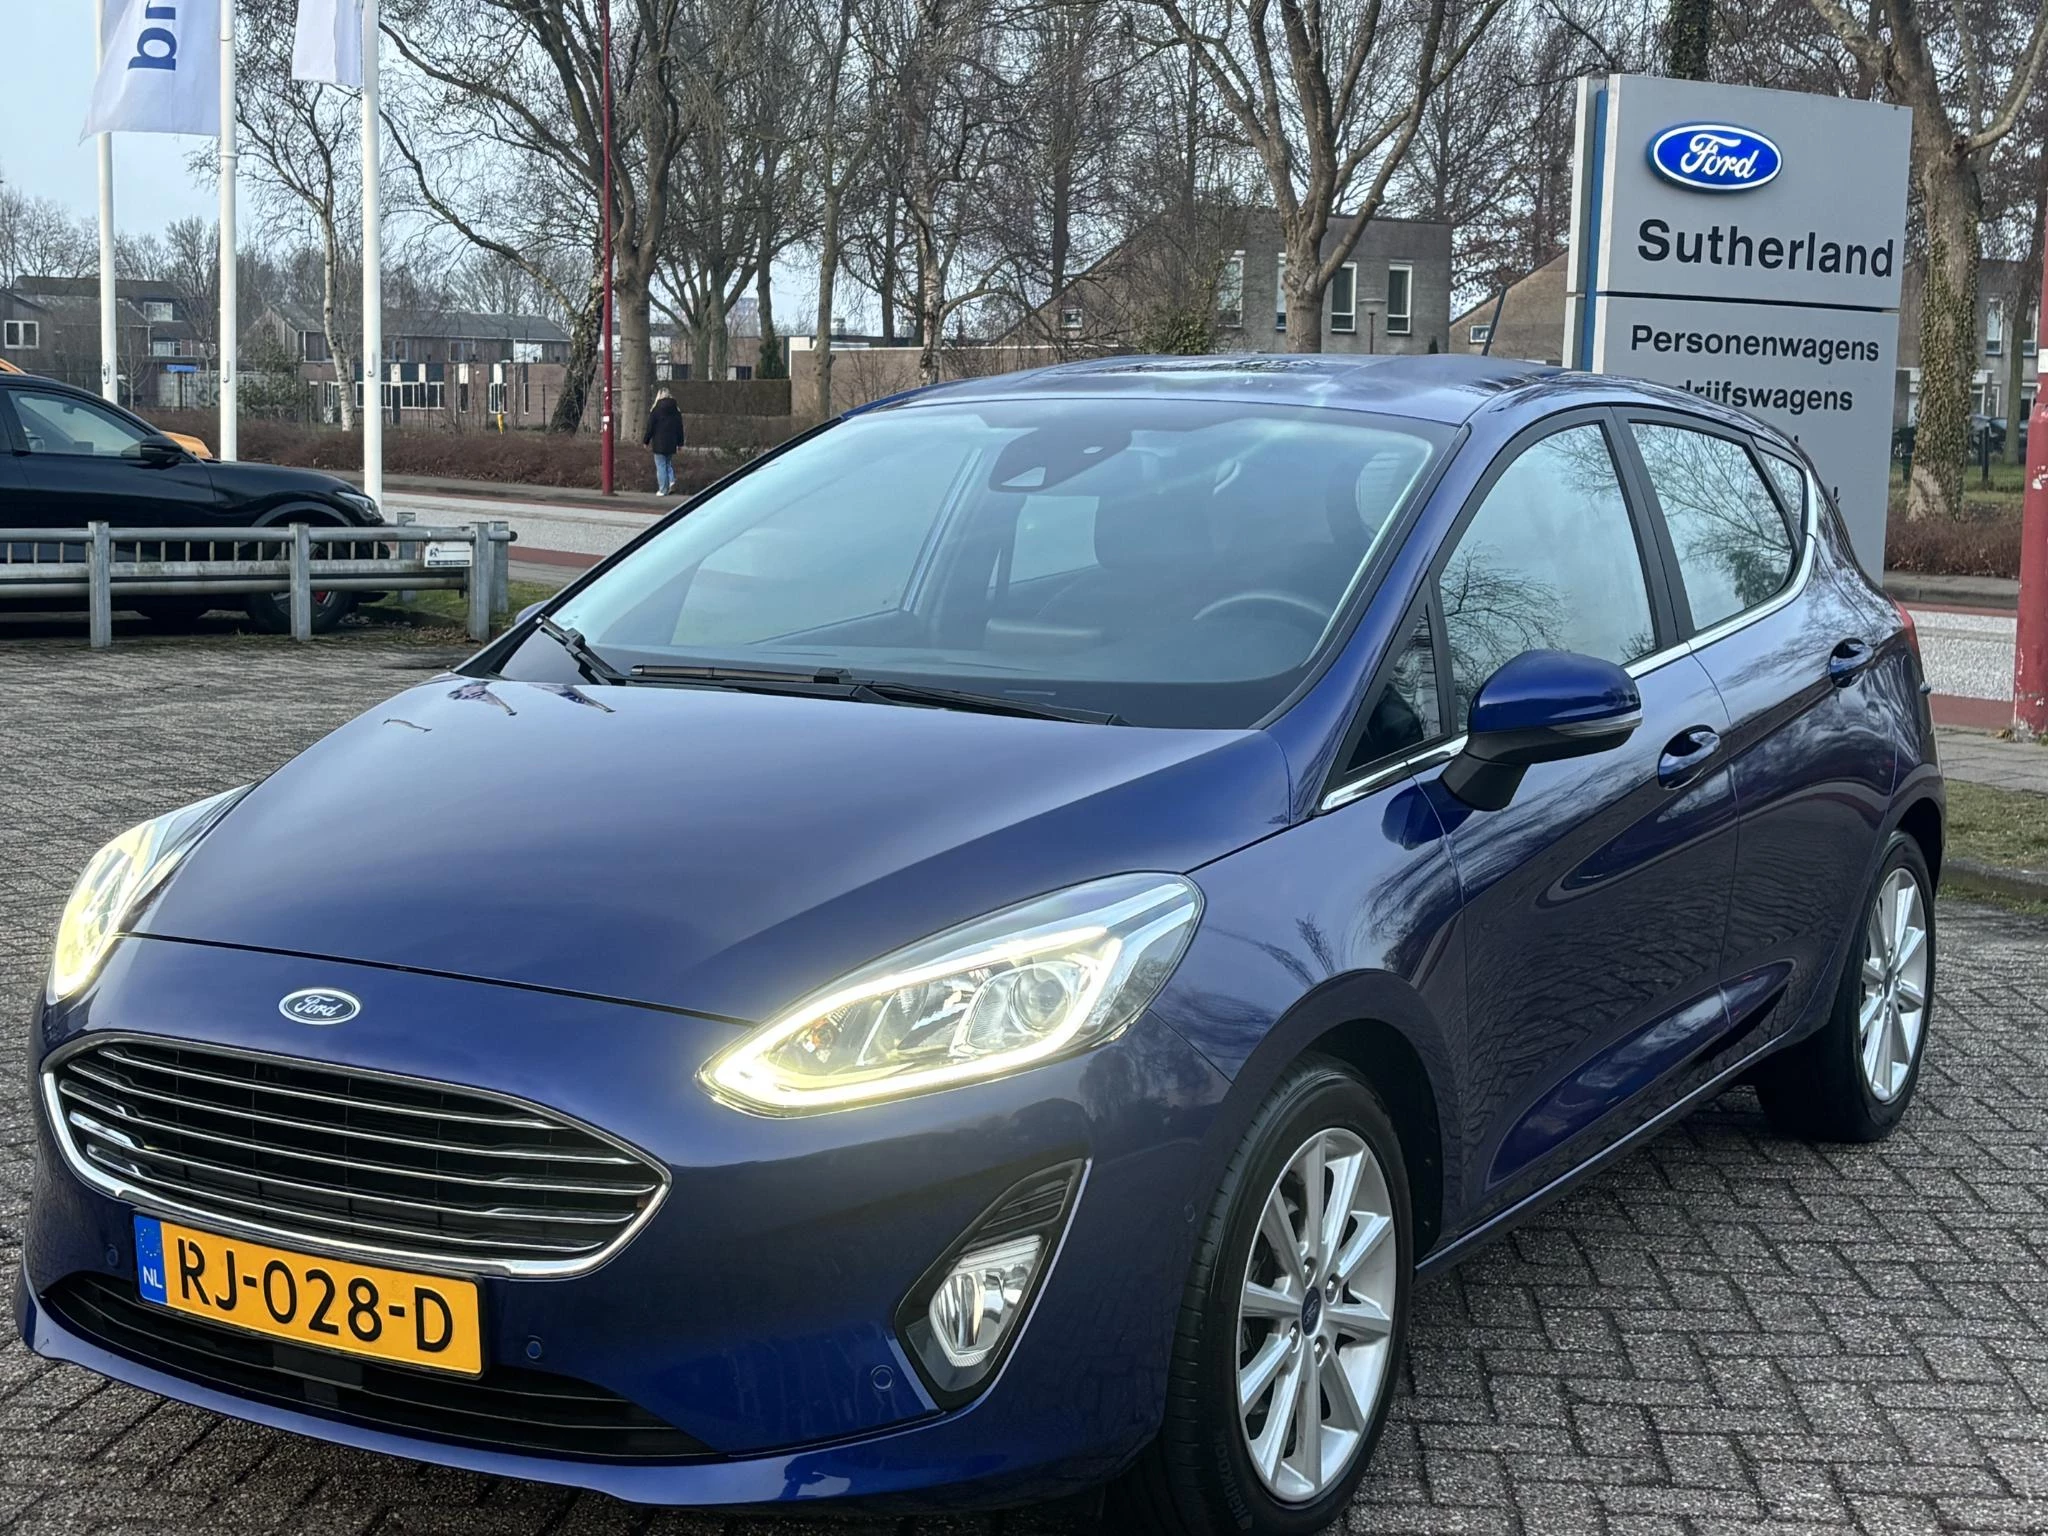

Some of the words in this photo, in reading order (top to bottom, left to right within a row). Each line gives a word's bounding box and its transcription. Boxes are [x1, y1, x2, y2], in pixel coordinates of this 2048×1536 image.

[1680, 133, 1759, 178] Ford
[1638, 219, 1893, 277] Sutherland
[1631, 325, 1879, 364] Personenwagens
[1677, 380, 1853, 415] ijfswagens
[294, 995, 343, 1016] Ford
[143, 1265, 163, 1289] NL
[177, 1238, 453, 1352] RJ-028-D
